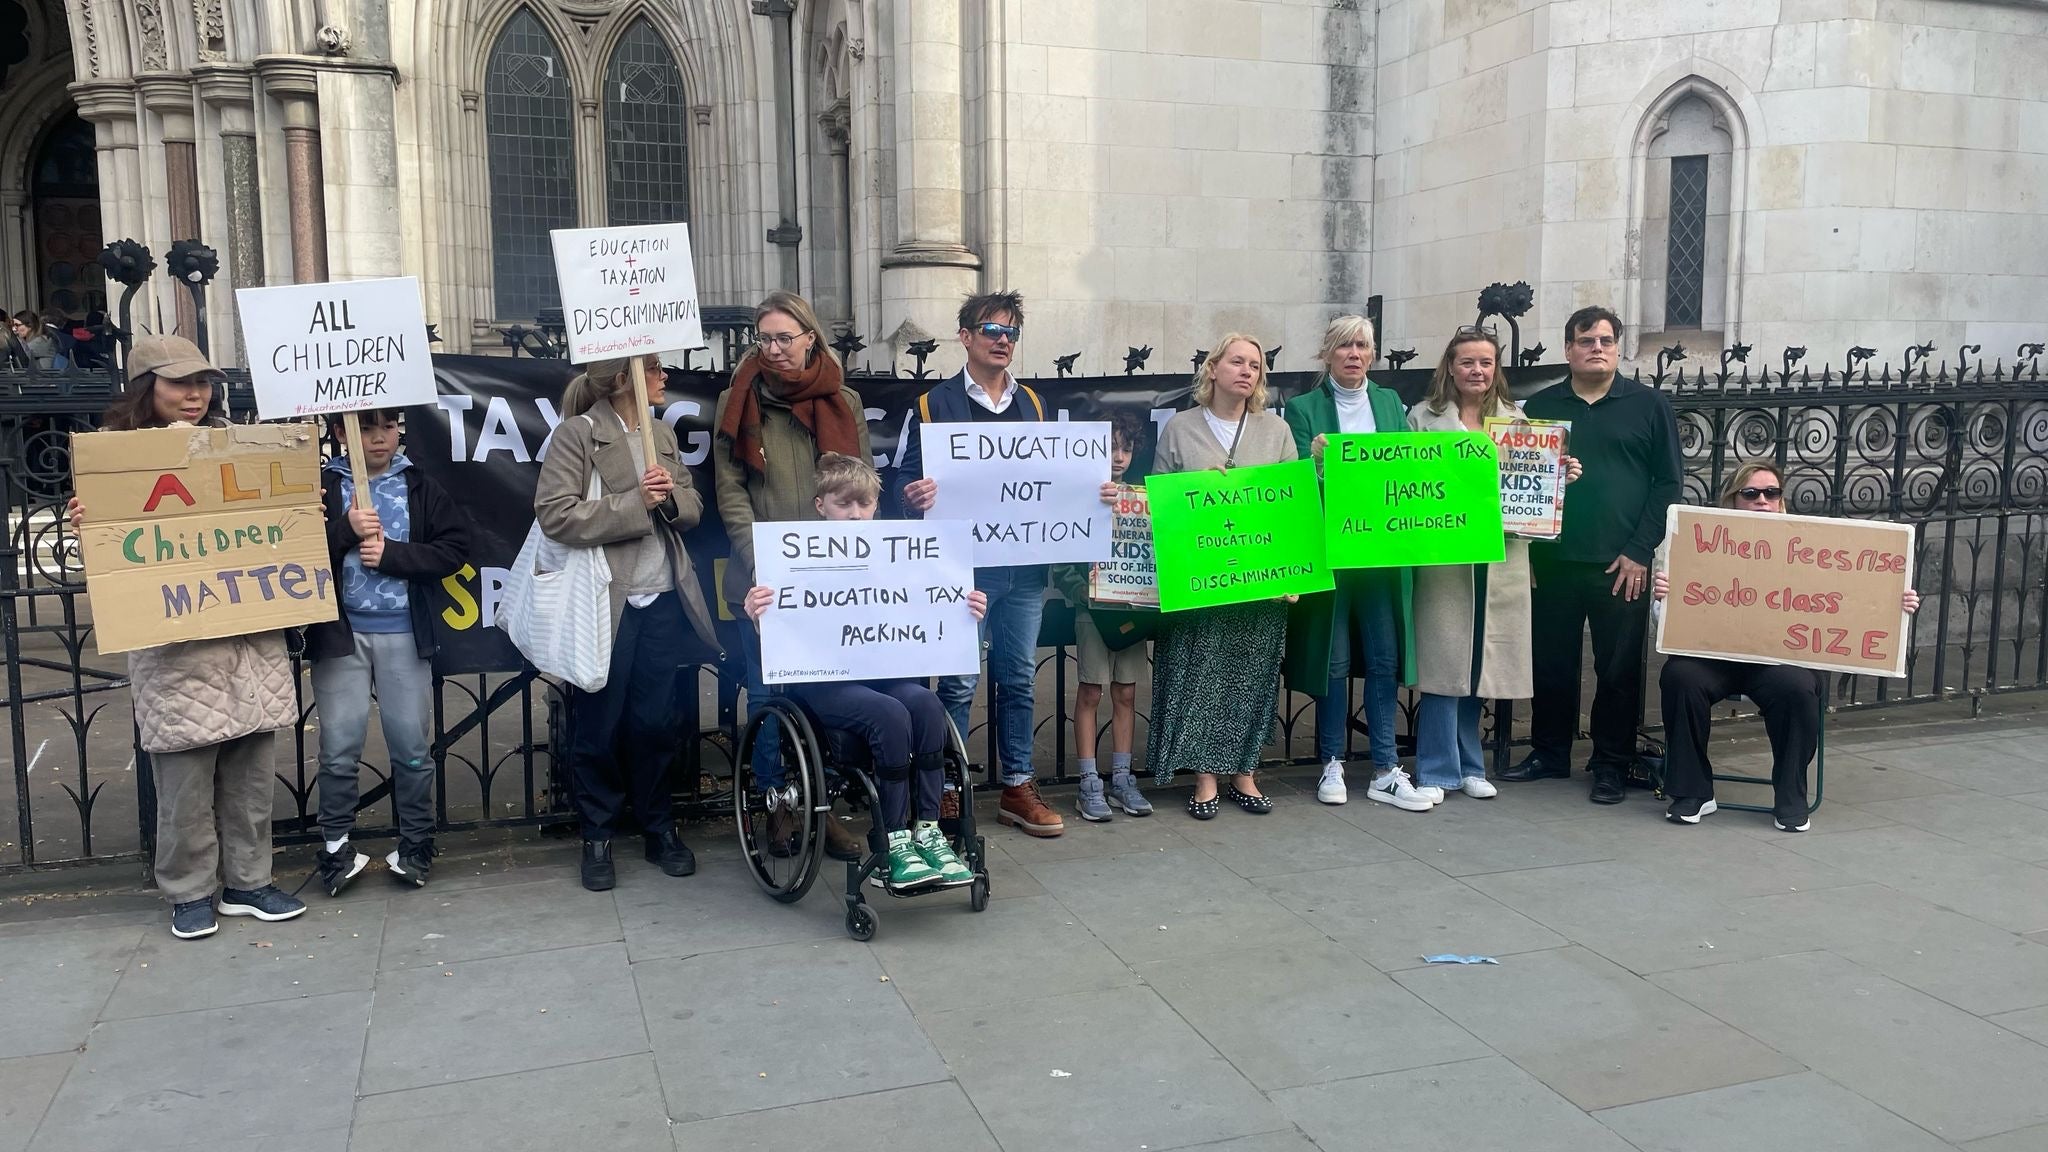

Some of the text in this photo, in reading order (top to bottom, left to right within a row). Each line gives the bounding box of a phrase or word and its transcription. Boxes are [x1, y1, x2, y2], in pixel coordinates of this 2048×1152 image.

[589, 237, 669, 257] EDUCATION
[600, 266, 665, 285] TAXATION
[309, 299, 356, 334] ALL
[573, 299, 696, 335] DISCRIMINATION
[272, 333, 405, 374] CHILDREN
[314, 371, 387, 403] MATTER
[950, 432, 1107, 460] EDUCATION
[1342, 438, 1493, 462] EDUCATION TAX
[1508, 450, 1541, 461] TAXES
[1499, 462, 1554, 474] ULNERABLE
[142, 461, 314, 512] ALL
[1000, 481, 1051, 503] NOT
[1384, 480, 1446, 507] HARMS
[1500, 474, 1542, 491] KIDS
[1184, 485, 1293, 510] TAXATION
[1510, 493, 1524, 503] OF
[1526, 494, 1554, 505] THEIR
[1116, 517, 1148, 528] TAXES
[1501, 505, 1543, 516] CHOOLS
[972, 517, 1092, 544] AXATION
[1341, 512, 1467, 535] ALL CHILDREN
[781, 532, 940, 563] SEND THE
[1111, 541, 1151, 560] KIDS
[1197, 532, 1273, 549] EDUCATION
[1693, 523, 1772, 560] When
[1098, 562, 1157, 573] OUT OF THEI
[1191, 562, 1313, 592] DISCRIMINATION
[1108, 574, 1153, 586] SCHOOLS
[777, 586, 967, 610] EDUCATION TAX
[1765, 586, 1844, 614] class
[1783, 623, 1889, 660] SIZE
